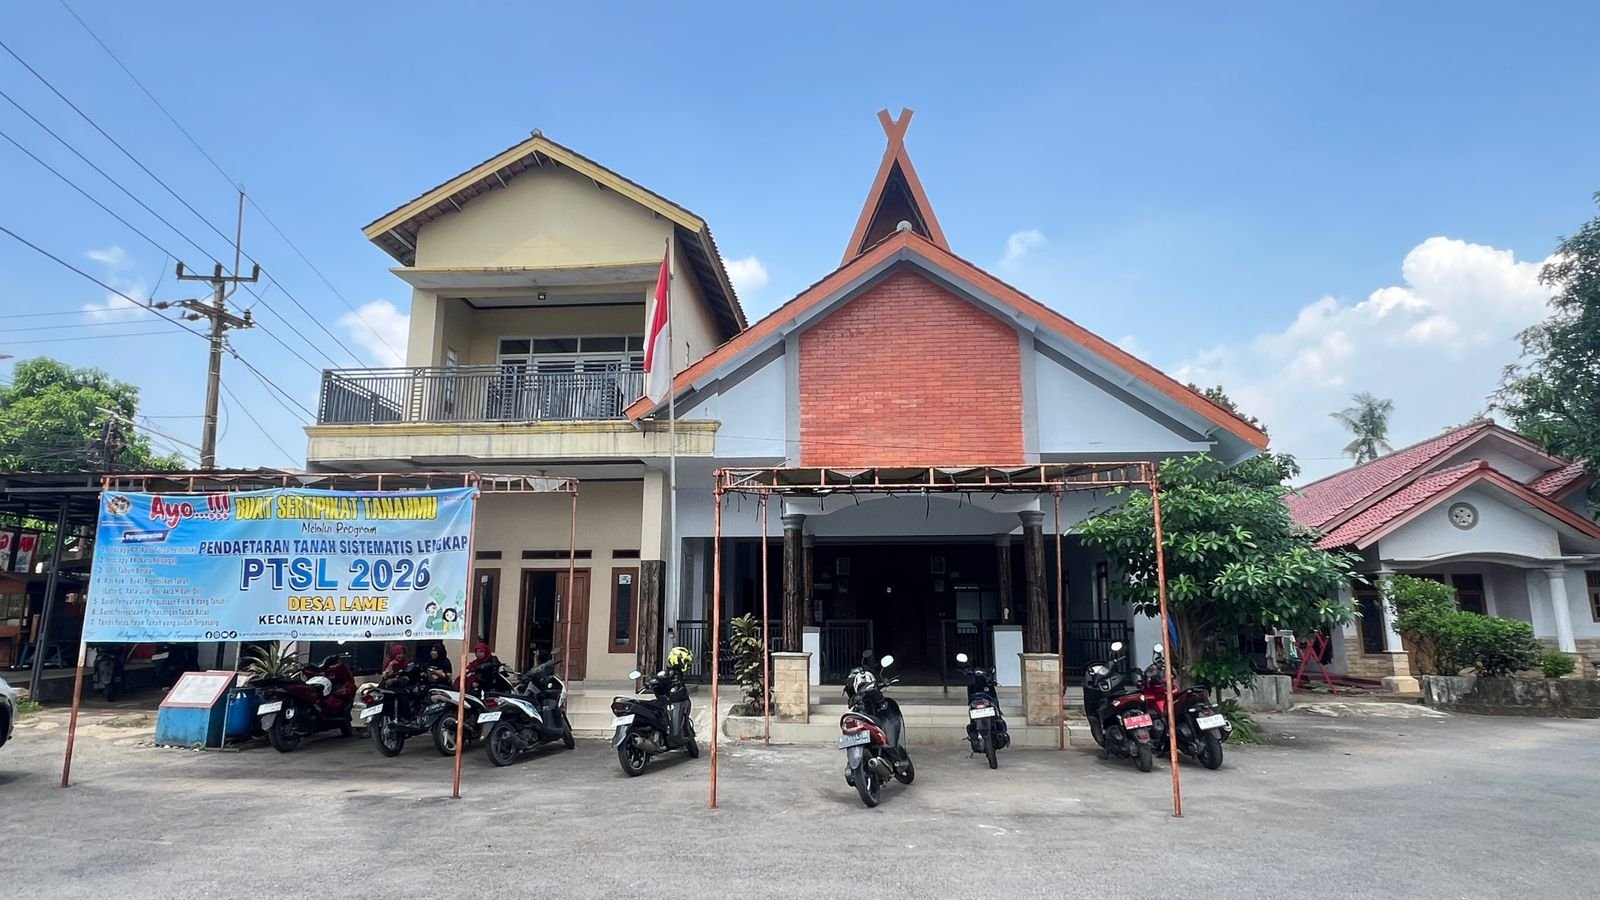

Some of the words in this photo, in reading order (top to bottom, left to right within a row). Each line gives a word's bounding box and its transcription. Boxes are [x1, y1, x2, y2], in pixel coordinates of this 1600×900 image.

[235, 496, 273, 520] BUAT
[277, 495, 359, 520] SERTIPIKAT
[363, 495, 438, 520] TANAHMU
[301, 522, 332, 534] Melalui
[335, 522, 377, 537] Program
[199, 540, 289, 556] PENDAFTARAN
[293, 540, 336, 555] TANAH
[340, 538, 413, 555] SISTEMATIS
[240, 557, 338, 591] PTSL
[349, 557, 430, 591] 2026
[288, 596, 335, 612] DESA
[340, 596, 389, 612] LAME
[258, 614, 324, 627] KECAMATAN
[328, 614, 413, 626] LEUWIMUNDING
